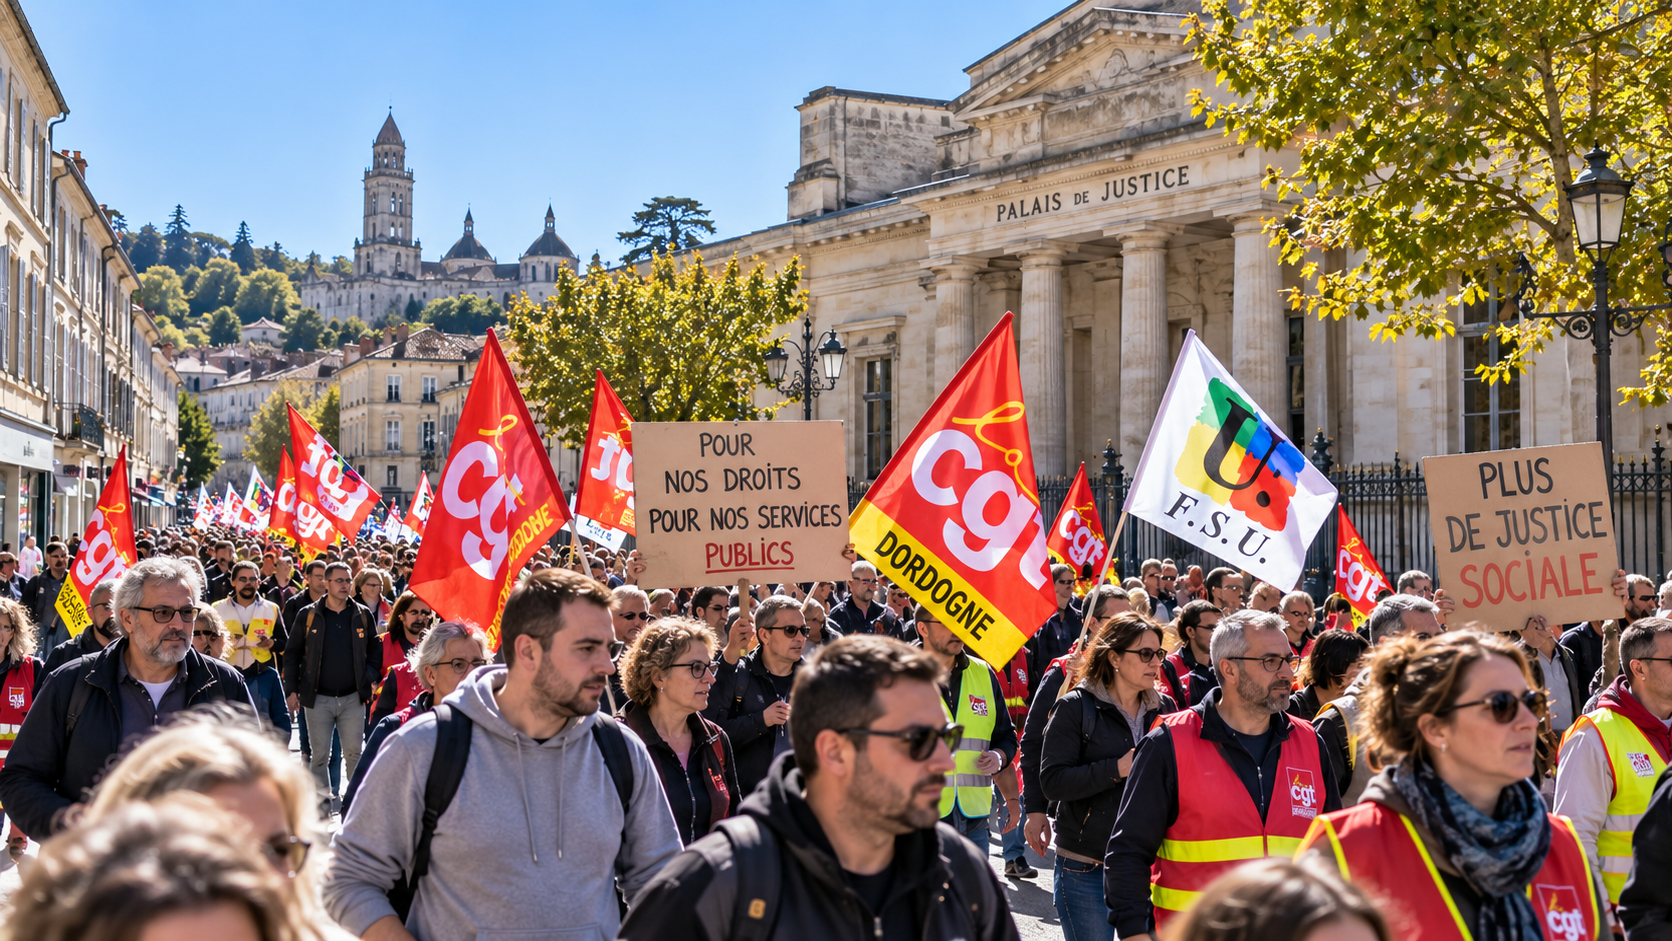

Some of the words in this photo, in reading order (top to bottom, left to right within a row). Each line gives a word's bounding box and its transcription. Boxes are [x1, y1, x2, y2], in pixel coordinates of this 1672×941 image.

[997, 192, 1062, 222] PALAIS
[1074, 191, 1090, 206] DE
[1101, 165, 1190, 202] JUSTICE
[699, 432, 756, 458] POUR
[664, 469, 709, 495] NOS
[1478, 457, 1554, 500] PLUS
[648, 508, 702, 534] POUR
[710, 506, 749, 531] NOS
[910, 429, 1049, 591] cgt
[1446, 513, 1486, 554] DE
[874, 530, 996, 641] DORDOGNE
[1290, 784, 1316, 807] cgt
[1547, 908, 1587, 941] cgt
